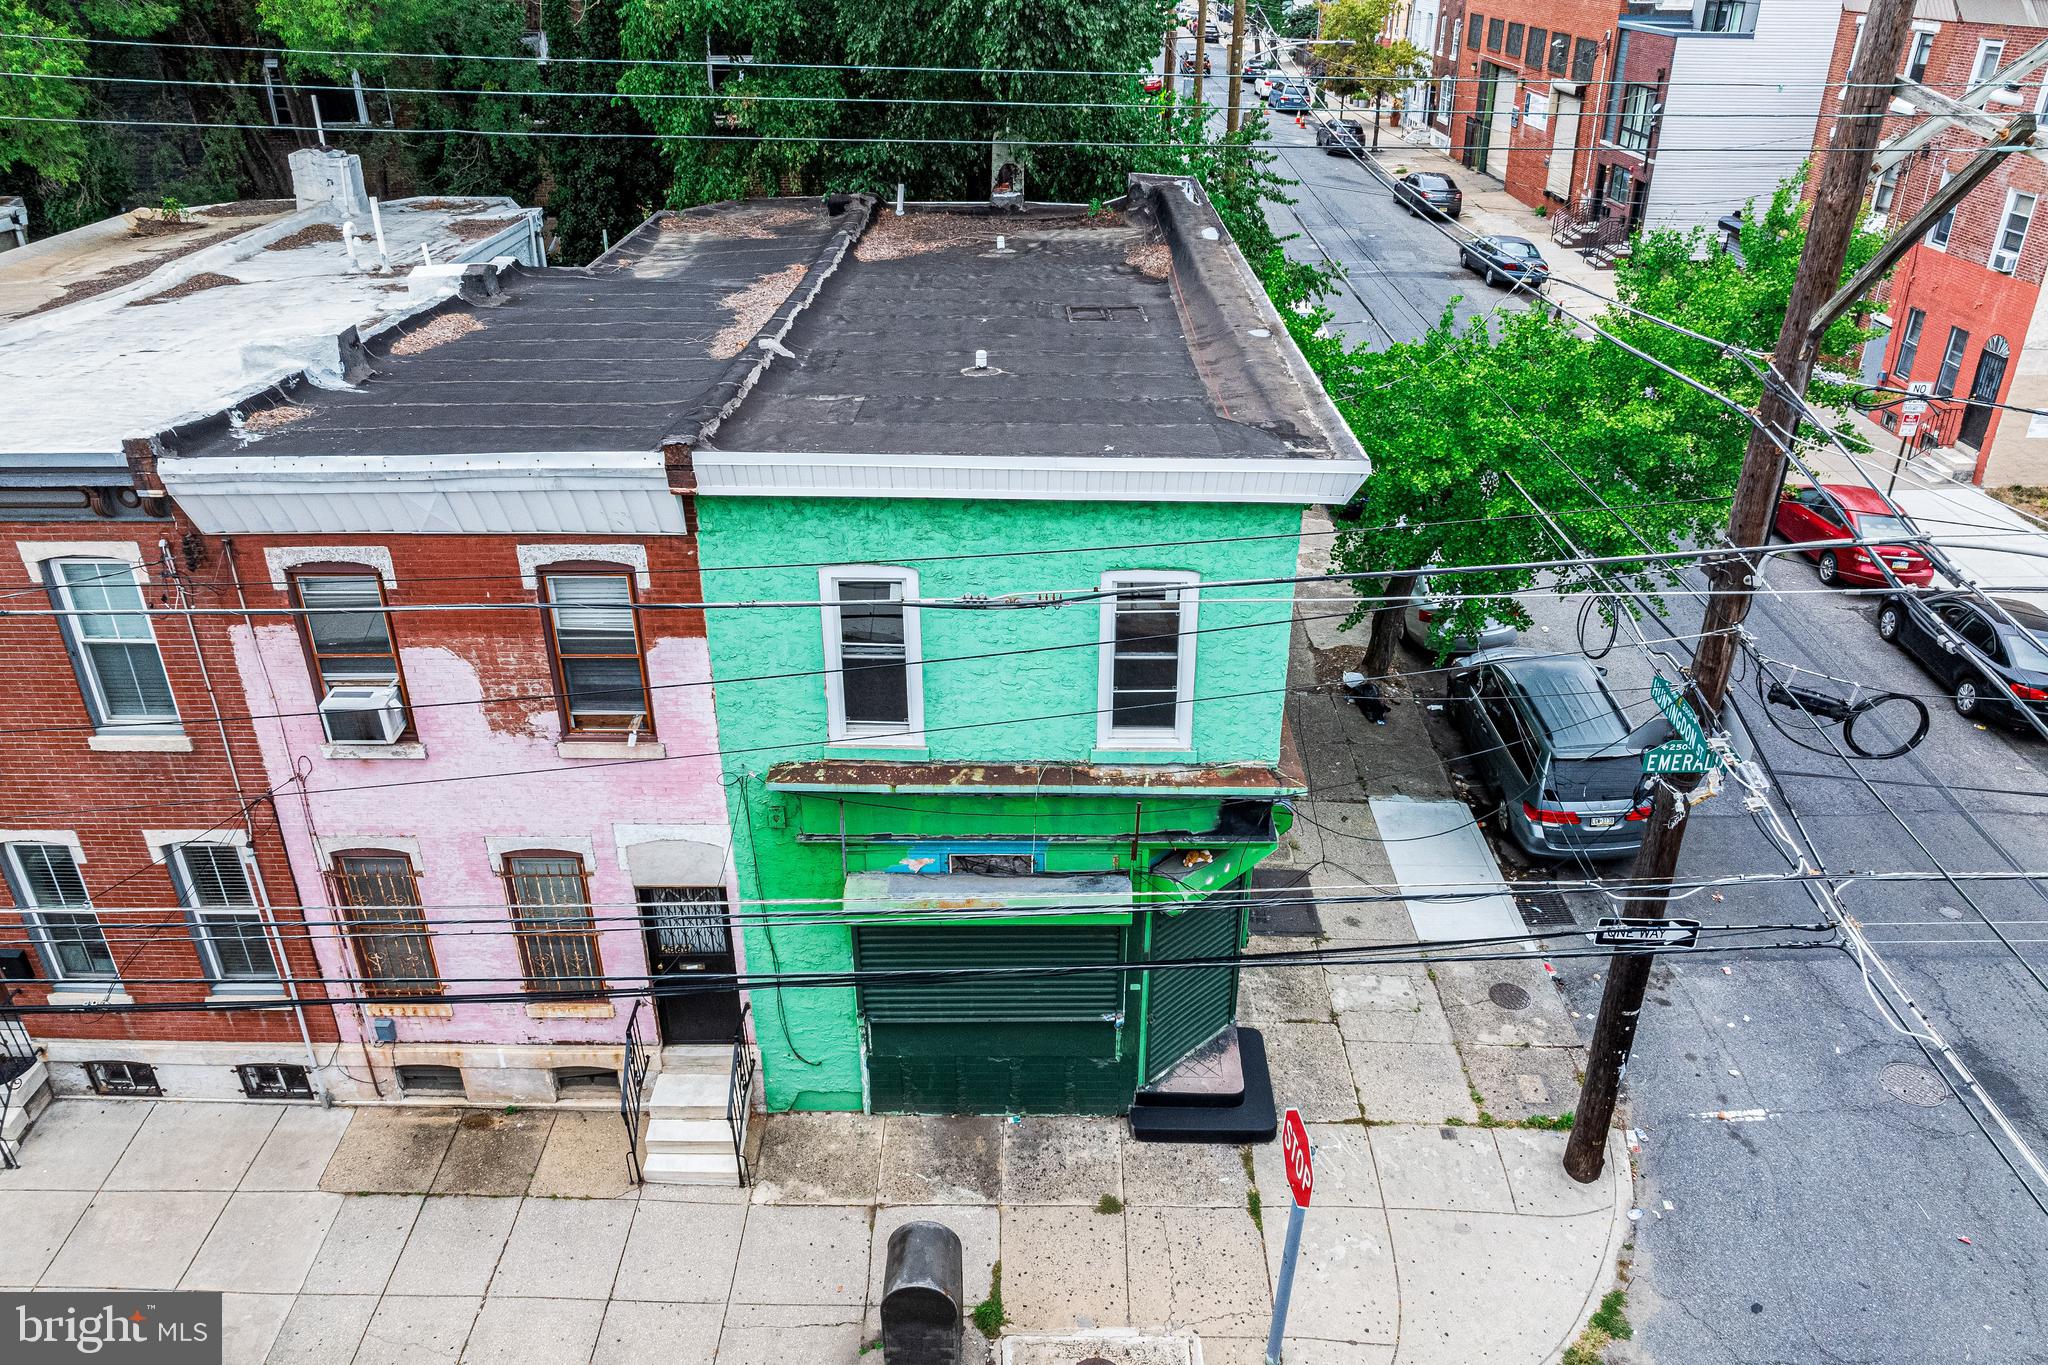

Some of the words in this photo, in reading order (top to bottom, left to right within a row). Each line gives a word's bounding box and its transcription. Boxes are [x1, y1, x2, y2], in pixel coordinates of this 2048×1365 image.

[1913, 384, 1927, 394] NO
[1652, 679, 1697, 749] HUNTINGDON
[1695, 743, 1705, 760] ST
[1607, 927, 1634, 938] ONE
[1640, 928, 1666, 939] WAY
[1284, 1120, 1311, 1190] STOP
